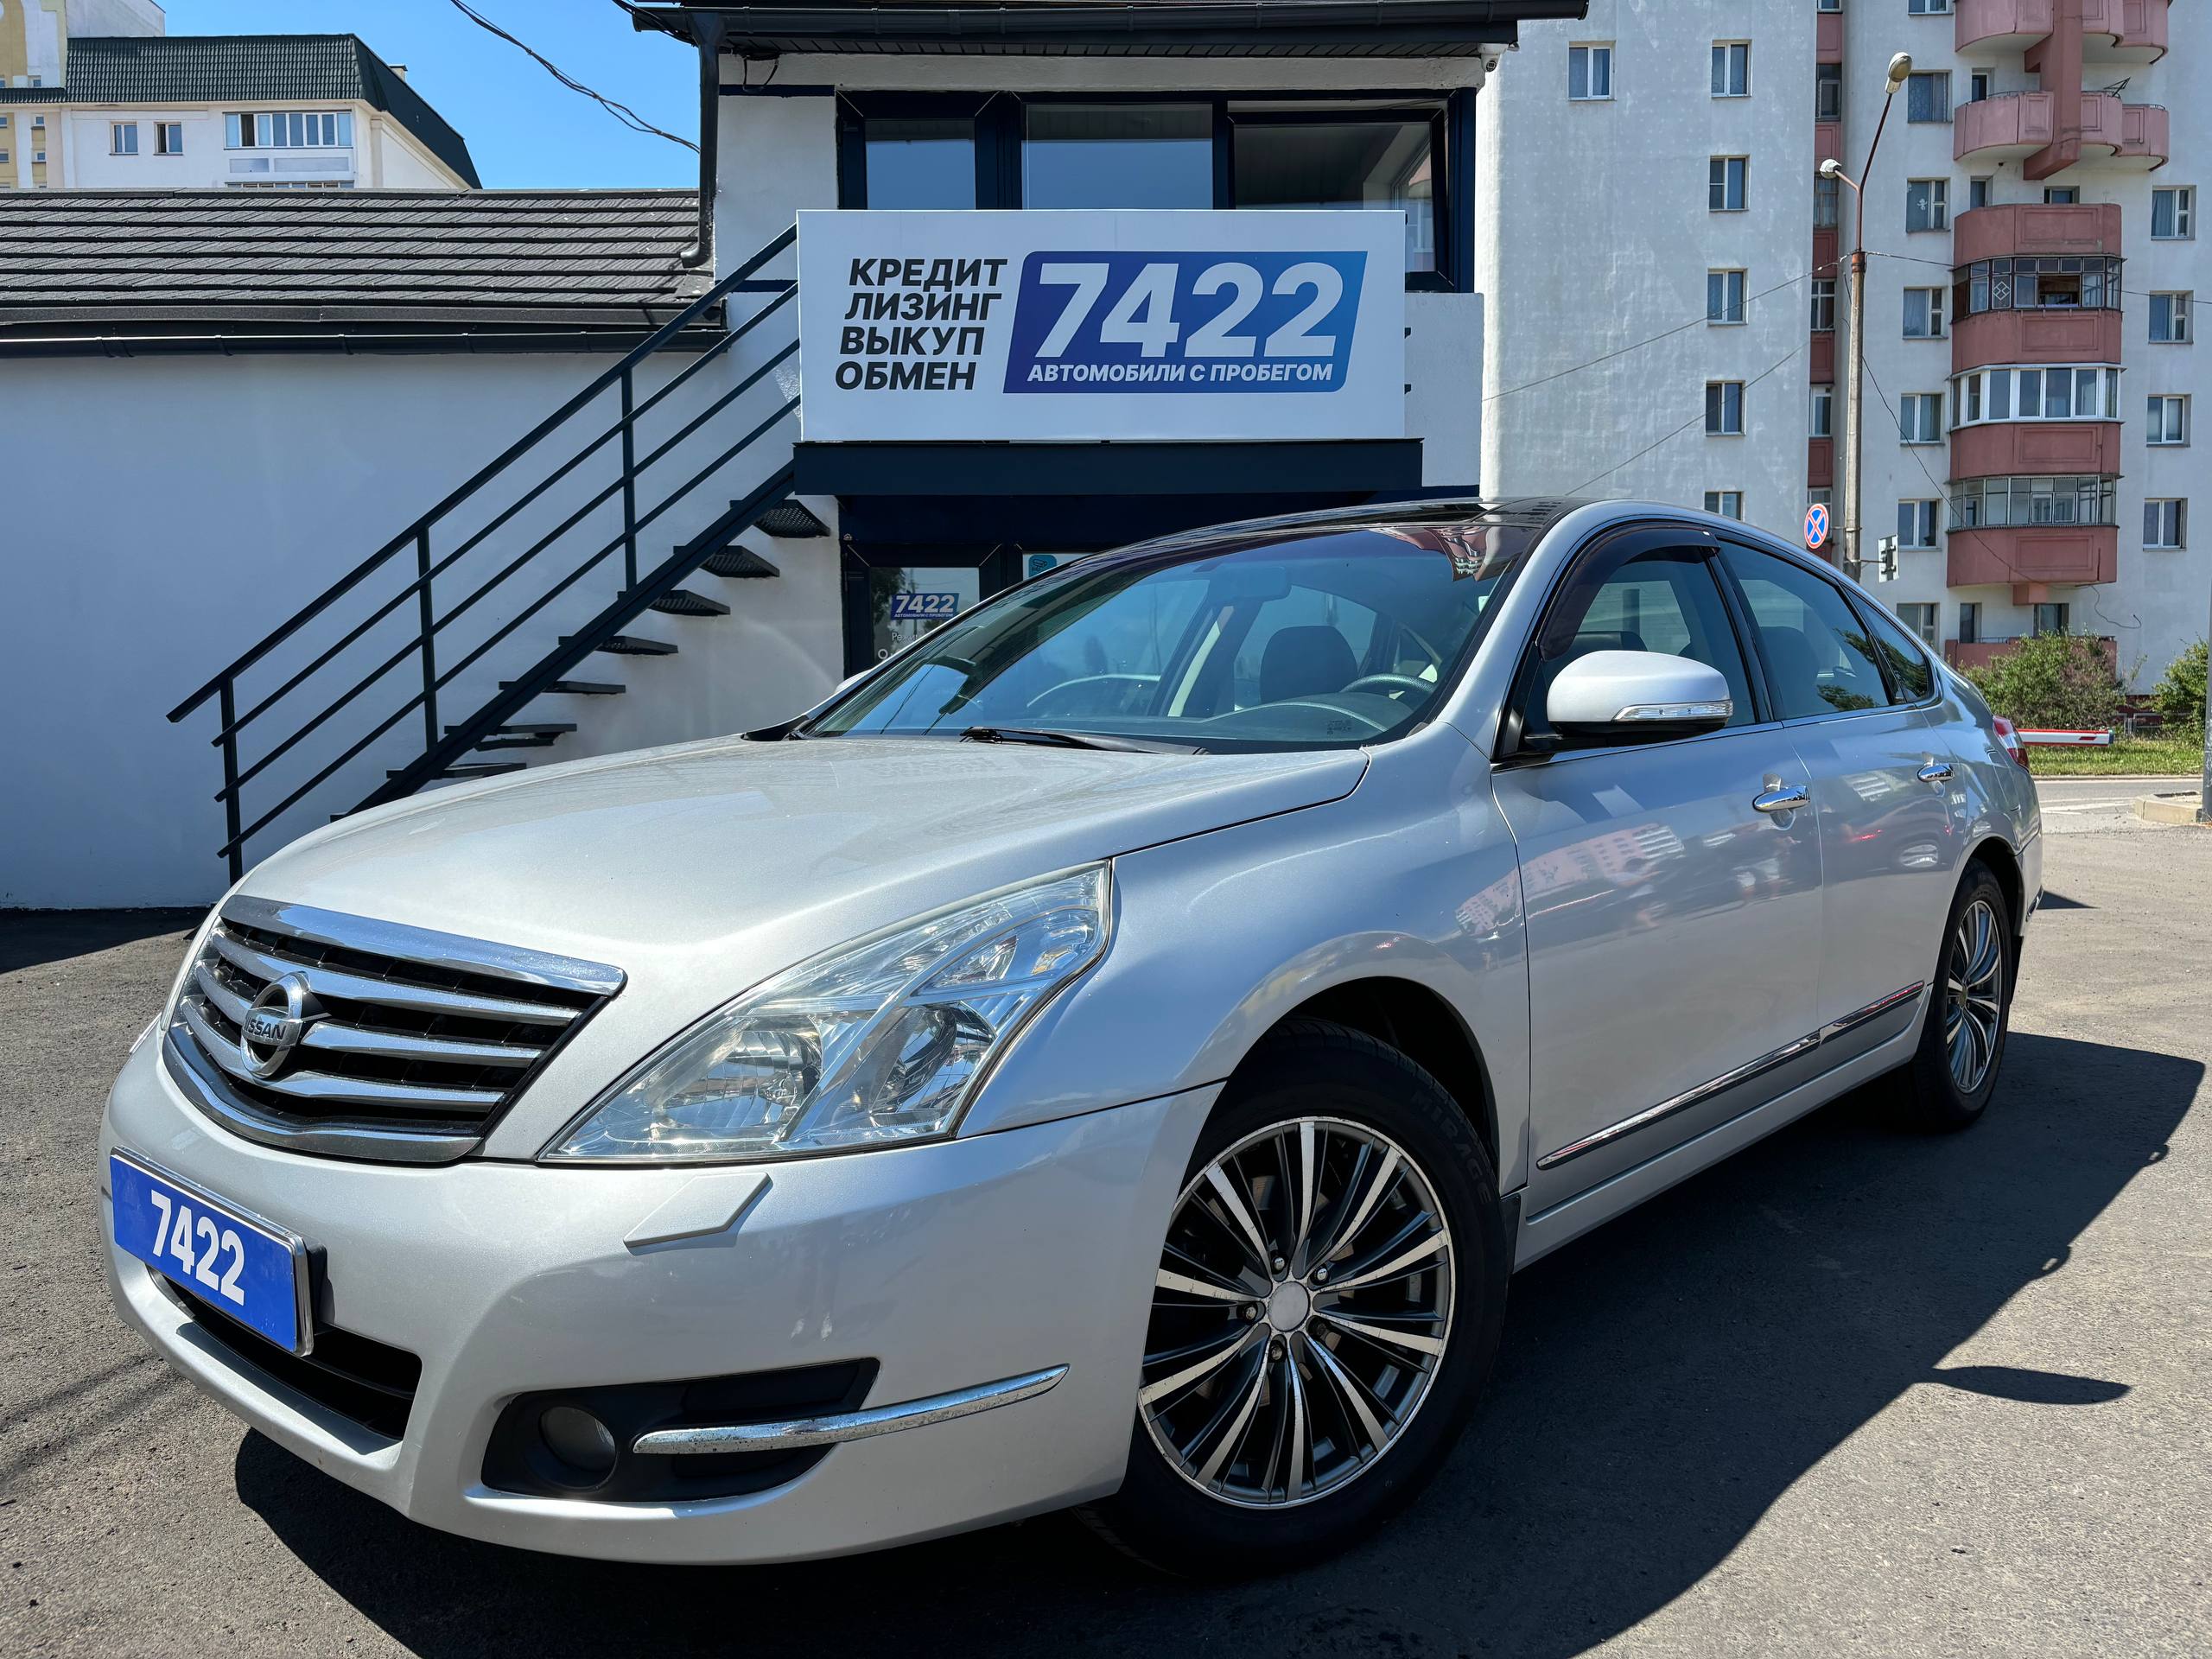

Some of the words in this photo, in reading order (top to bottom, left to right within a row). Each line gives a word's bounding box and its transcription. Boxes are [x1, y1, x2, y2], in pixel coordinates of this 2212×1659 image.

[849, 258, 1007, 292] КРЕДИТ
[844, 293, 1002, 321] ЛИЗИНГ
[1035, 262, 1344, 359] 7422
[840, 326, 985, 356] ВЫКУП
[835, 361, 976, 391] ОБМЕН
[1027, 364, 1185, 382] АВТОМОБИЛИ
[1189, 364, 1205, 381] С
[1210, 363, 1333, 381] ПРОБЕГОМ
[895, 594, 955, 613] 7422
[150, 1189, 245, 1306] 7422
